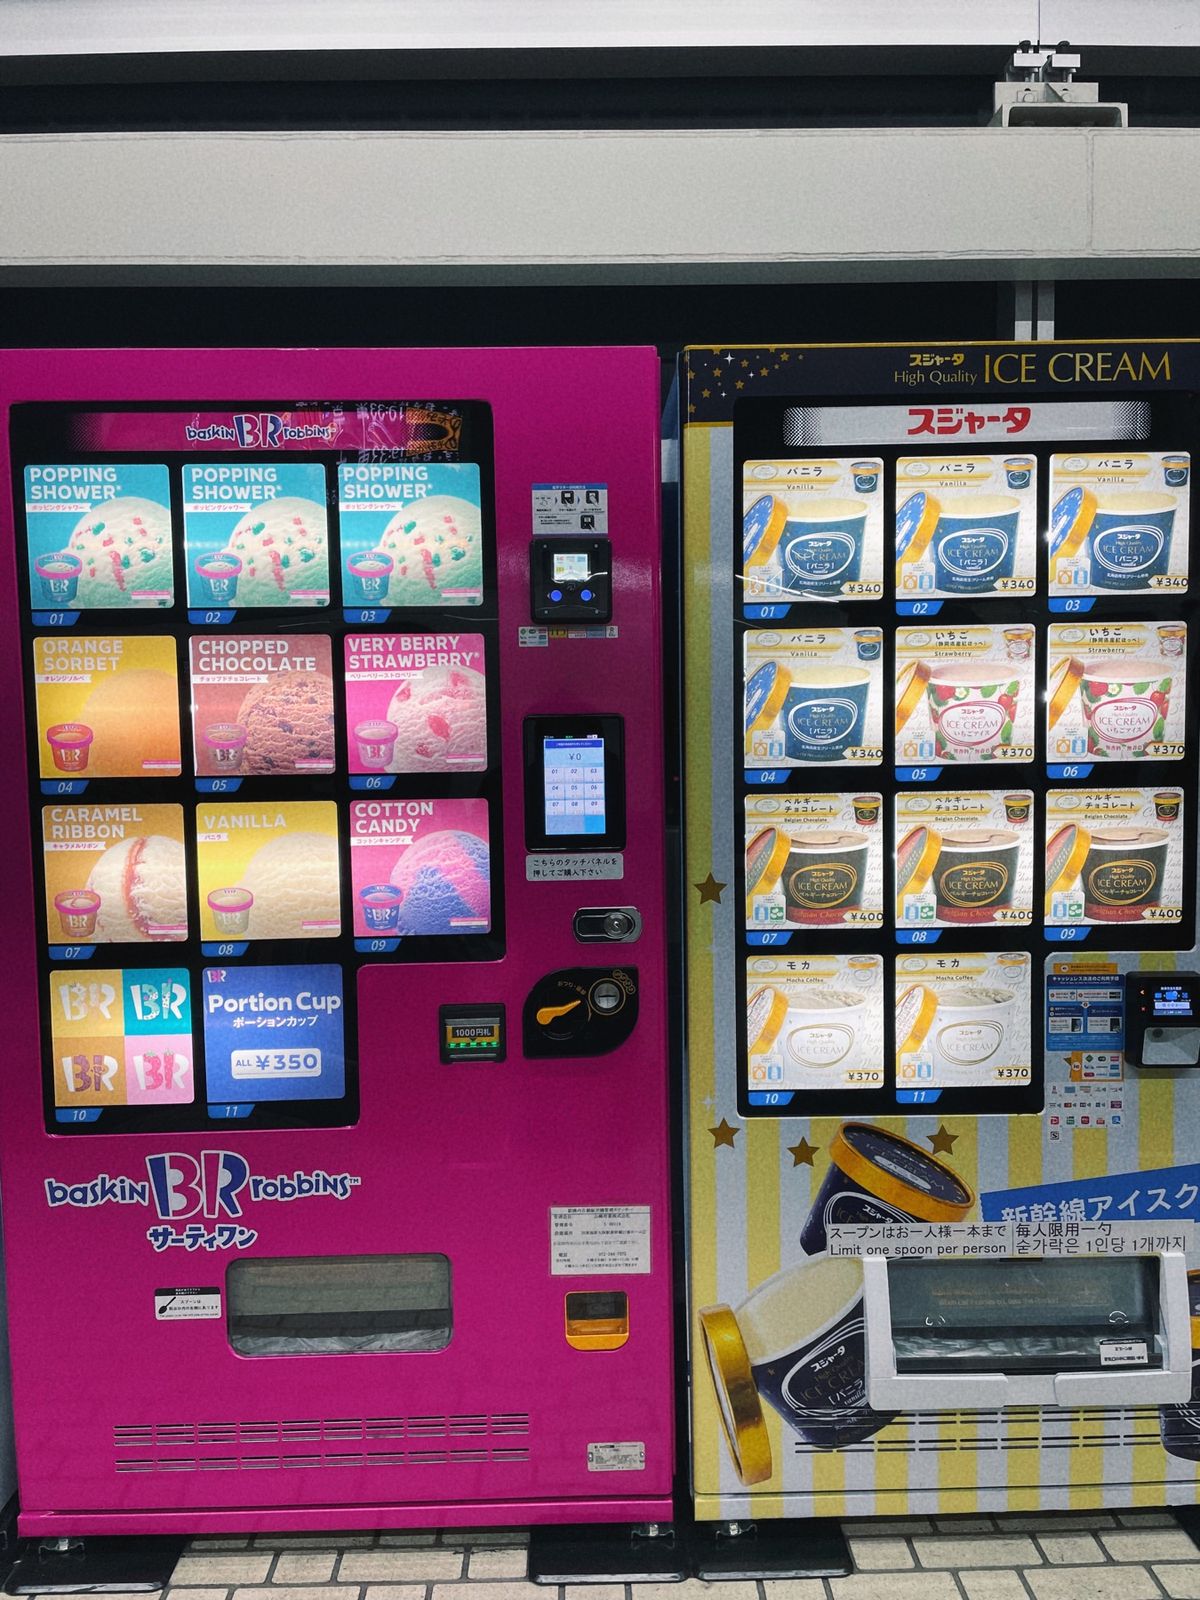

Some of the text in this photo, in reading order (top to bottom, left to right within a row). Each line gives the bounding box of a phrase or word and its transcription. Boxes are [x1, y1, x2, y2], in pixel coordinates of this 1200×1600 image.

[909, 353, 964, 367] スジャータ
[894, 352, 1172, 386] High Quality ICE CREAM
[907, 406, 1031, 435] スジャータ
[186, 424, 236, 441] baskin
[233, 413, 283, 447] BR
[940, 464, 975, 473] バニラ
[1098, 459, 1134, 470] バニラ
[30, 467, 117, 482] POPPING
[192, 468, 277, 482] POPPING
[343, 466, 428, 481] POPPING
[787, 466, 823, 476] バニラ
[1002, 580, 1034, 589] ¥340
[1156, 578, 1188, 587] ¥340
[849, 584, 881, 593] ¥340
[913, 603, 928, 614] 02
[1065, 600, 1080, 611] 03
[361, 611, 376, 621] 03
[761, 606, 775, 617] 01
[50, 613, 64, 624] 01
[205, 612, 220, 623] 02
[936, 630, 969, 640] いちご
[1089, 627, 1122, 636] いちご
[348, 636, 460, 652] VERY BERRY
[791, 634, 826, 644] バニラ
[43, 640, 124, 654] ORANGE
[199, 640, 288, 654] CHOPPED
[44, 656, 119, 671] SORBET
[199, 657, 316, 671] CHOCOLATE
[964, 720, 998, 728] CREAM
[1100, 717, 1151, 726] ICE CREAM
[851, 749, 883, 758] ¥340
[1001, 748, 1033, 757] ¥370
[1154, 745, 1185, 755] ¥370
[569, 753, 582, 761] ¥0
[761, 771, 775, 782] 04
[912, 769, 927, 779] 05
[1063, 766, 1078, 777] 06
[58, 781, 73, 793] 04
[212, 780, 227, 791] 05
[366, 777, 381, 788] 06
[355, 802, 433, 817] COTTON
[51, 808, 143, 823] CARAMEL
[204, 814, 286, 829] VANILLA
[355, 819, 421, 834] CANDY
[52, 825, 125, 839] RIBBON
[533, 858, 617, 867] こちらのタッチパネルを
[533, 869, 602, 877] 押してご購入下さい
[798, 882, 848, 890] ICE CREAM
[1097, 879, 1147, 887] ICE CREAM
[851, 912, 883, 921] ¥400
[1001, 911, 1033, 919] ¥400
[1150, 909, 1182, 918] ¥400
[762, 934, 777, 944] 07
[912, 932, 927, 942] 08
[1061, 929, 1076, 939] 09
[218, 944, 234, 955] 08
[371, 940, 386, 951] 09
[65, 948, 80, 958] 07
[787, 961, 810, 970] モカ
[936, 959, 960, 968] モカ
[206, 970, 227, 983] BR
[208, 992, 341, 1015] Portion Cup
[232, 1015, 318, 1028] ポーションカップ
[455, 1028, 491, 1037] 1000円札
[236, 1054, 318, 1071] ALL ¥350
[849, 1072, 879, 1081] ¥370
[998, 1068, 1028, 1077] ¥370
[765, 1093, 778, 1104] 10
[913, 1092, 926, 1102] 11
[72, 1110, 87, 1121] 10
[225, 1106, 239, 1117] 11
[44, 1174, 148, 1207] baskin
[145, 1150, 250, 1220] BR
[147, 1223, 258, 1252] サーティワン
[830, 1225, 1006, 1239] スープンはお一人様一本まで
[1087, 1237, 1125, 1253] 1인당
[1133, 1236, 1186, 1252] 1개까지
[830, 1245, 1006, 1257] Limit one spoon per person
